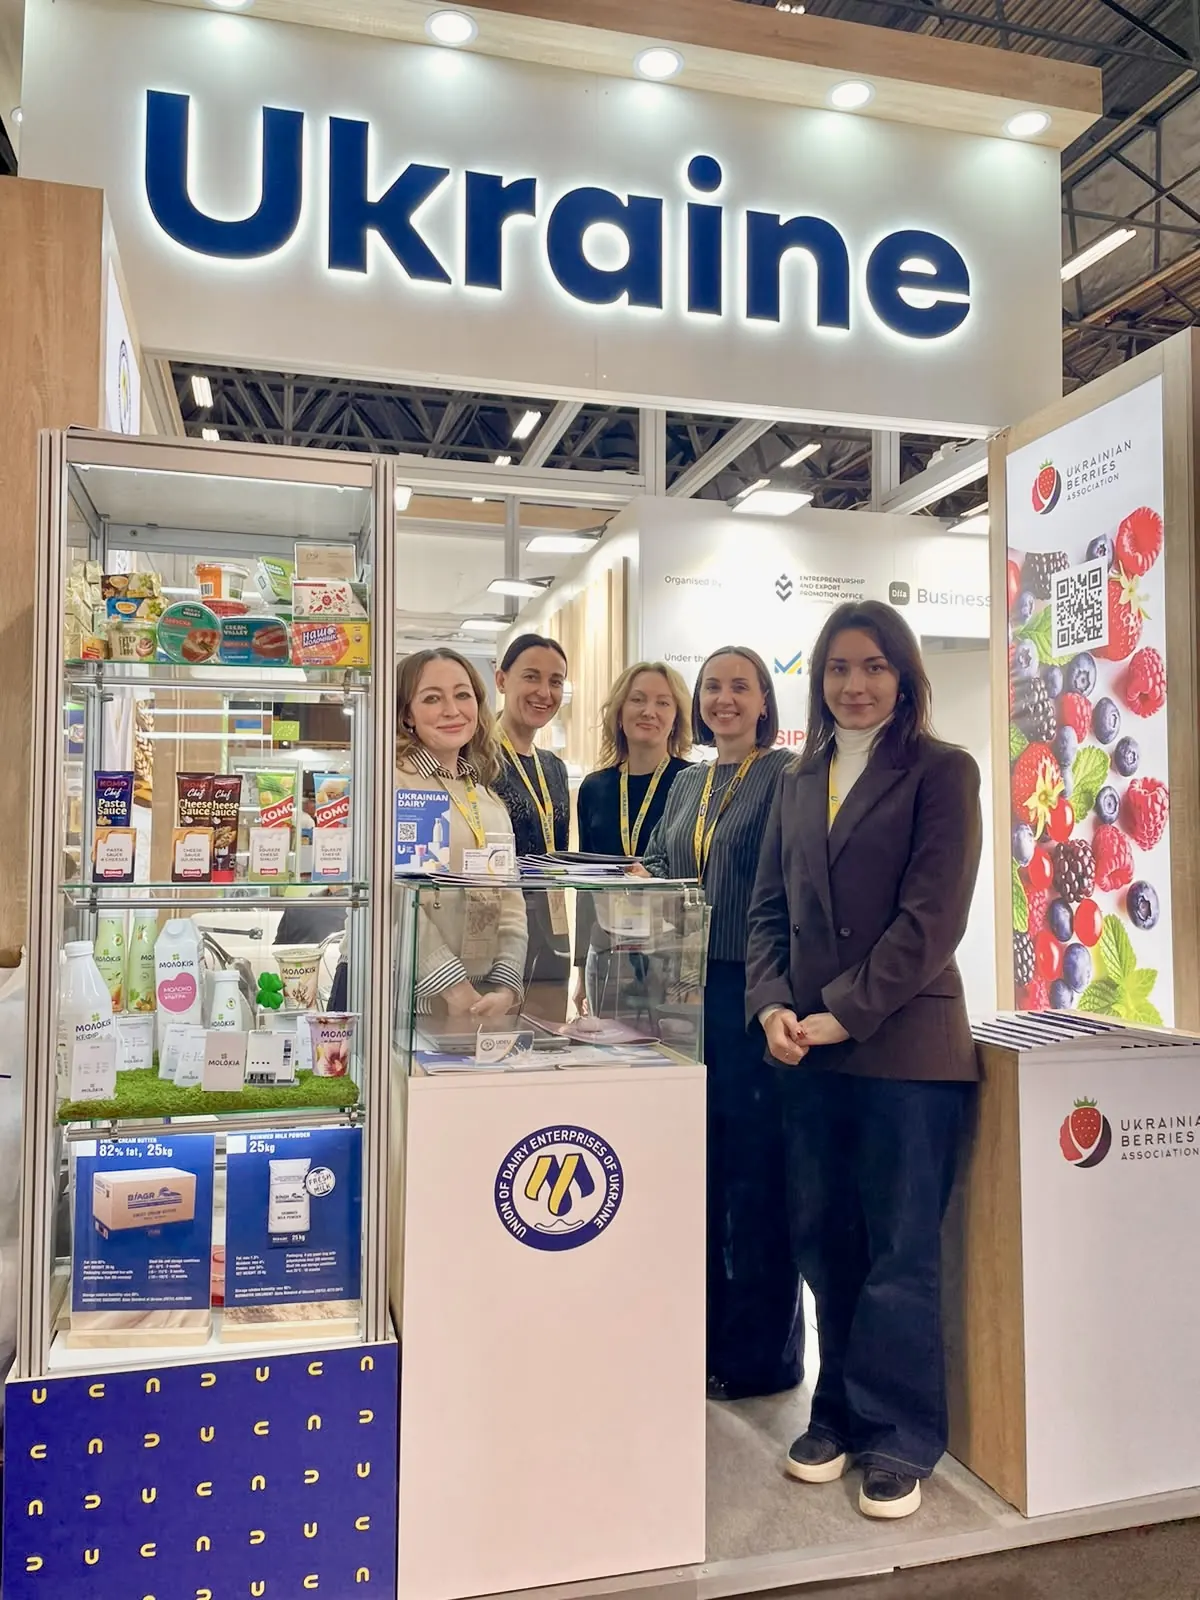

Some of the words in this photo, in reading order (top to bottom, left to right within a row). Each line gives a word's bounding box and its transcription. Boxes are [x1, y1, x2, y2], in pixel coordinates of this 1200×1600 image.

[145, 89, 972, 340] Ukraine
[1066, 439, 1132, 478] UKRAINIAN
[1066, 460, 1117, 490] BERRIES
[1066, 473, 1119, 501] ASSOCIATION
[664, 575, 710, 586] Organised
[800, 575, 865, 585] ENTREPRENEURSHIP
[800, 590, 840, 598] PROMOTION
[840, 592, 864, 600] OFFICE
[917, 588, 992, 607] Business
[664, 652, 692, 662] Under
[103, 787, 122, 798] Chef
[187, 788, 206, 800] Chef
[214, 789, 232, 801] Chef
[397, 792, 449, 802] UKRAINIAN
[98, 798, 127, 808] Pasta
[178, 799, 212, 809] Cheese
[212, 799, 240, 810] heese
[397, 800, 426, 808] DAIRY
[97, 806, 128, 816] Sauce
[180, 807, 210, 817] Sauce
[260, 802, 295, 825] KOMO
[315, 802, 350, 825] KOMO
[158, 960, 194, 969] МОЛОКІЯ
[281, 966, 316, 975] МОЛОКІЯ
[75, 1018, 112, 1033] МОЛОКІЯ
[207, 1059, 240, 1067] MOLOKIA
[529, 1129, 608, 1157] ENTERPRISES
[1121, 1131, 1195, 1148] BERRIES
[99, 1144, 124, 1157] 82%
[125, 1148, 143, 1158] fat,
[146, 1143, 173, 1158] 25kg
[249, 1140, 276, 1154] 25kg
[1121, 1147, 1200, 1161] ASSOCIATION
[502, 1143, 529, 1180] DAIRY
[603, 1154, 618, 1171] OF
[308, 1173, 332, 1186] FRESH
[313, 1184, 332, 1194] MILK
[498, 1181, 510, 1199] OF
[593, 1173, 620, 1229] UKRAINE
[500, 1201, 527, 1238] UNION
